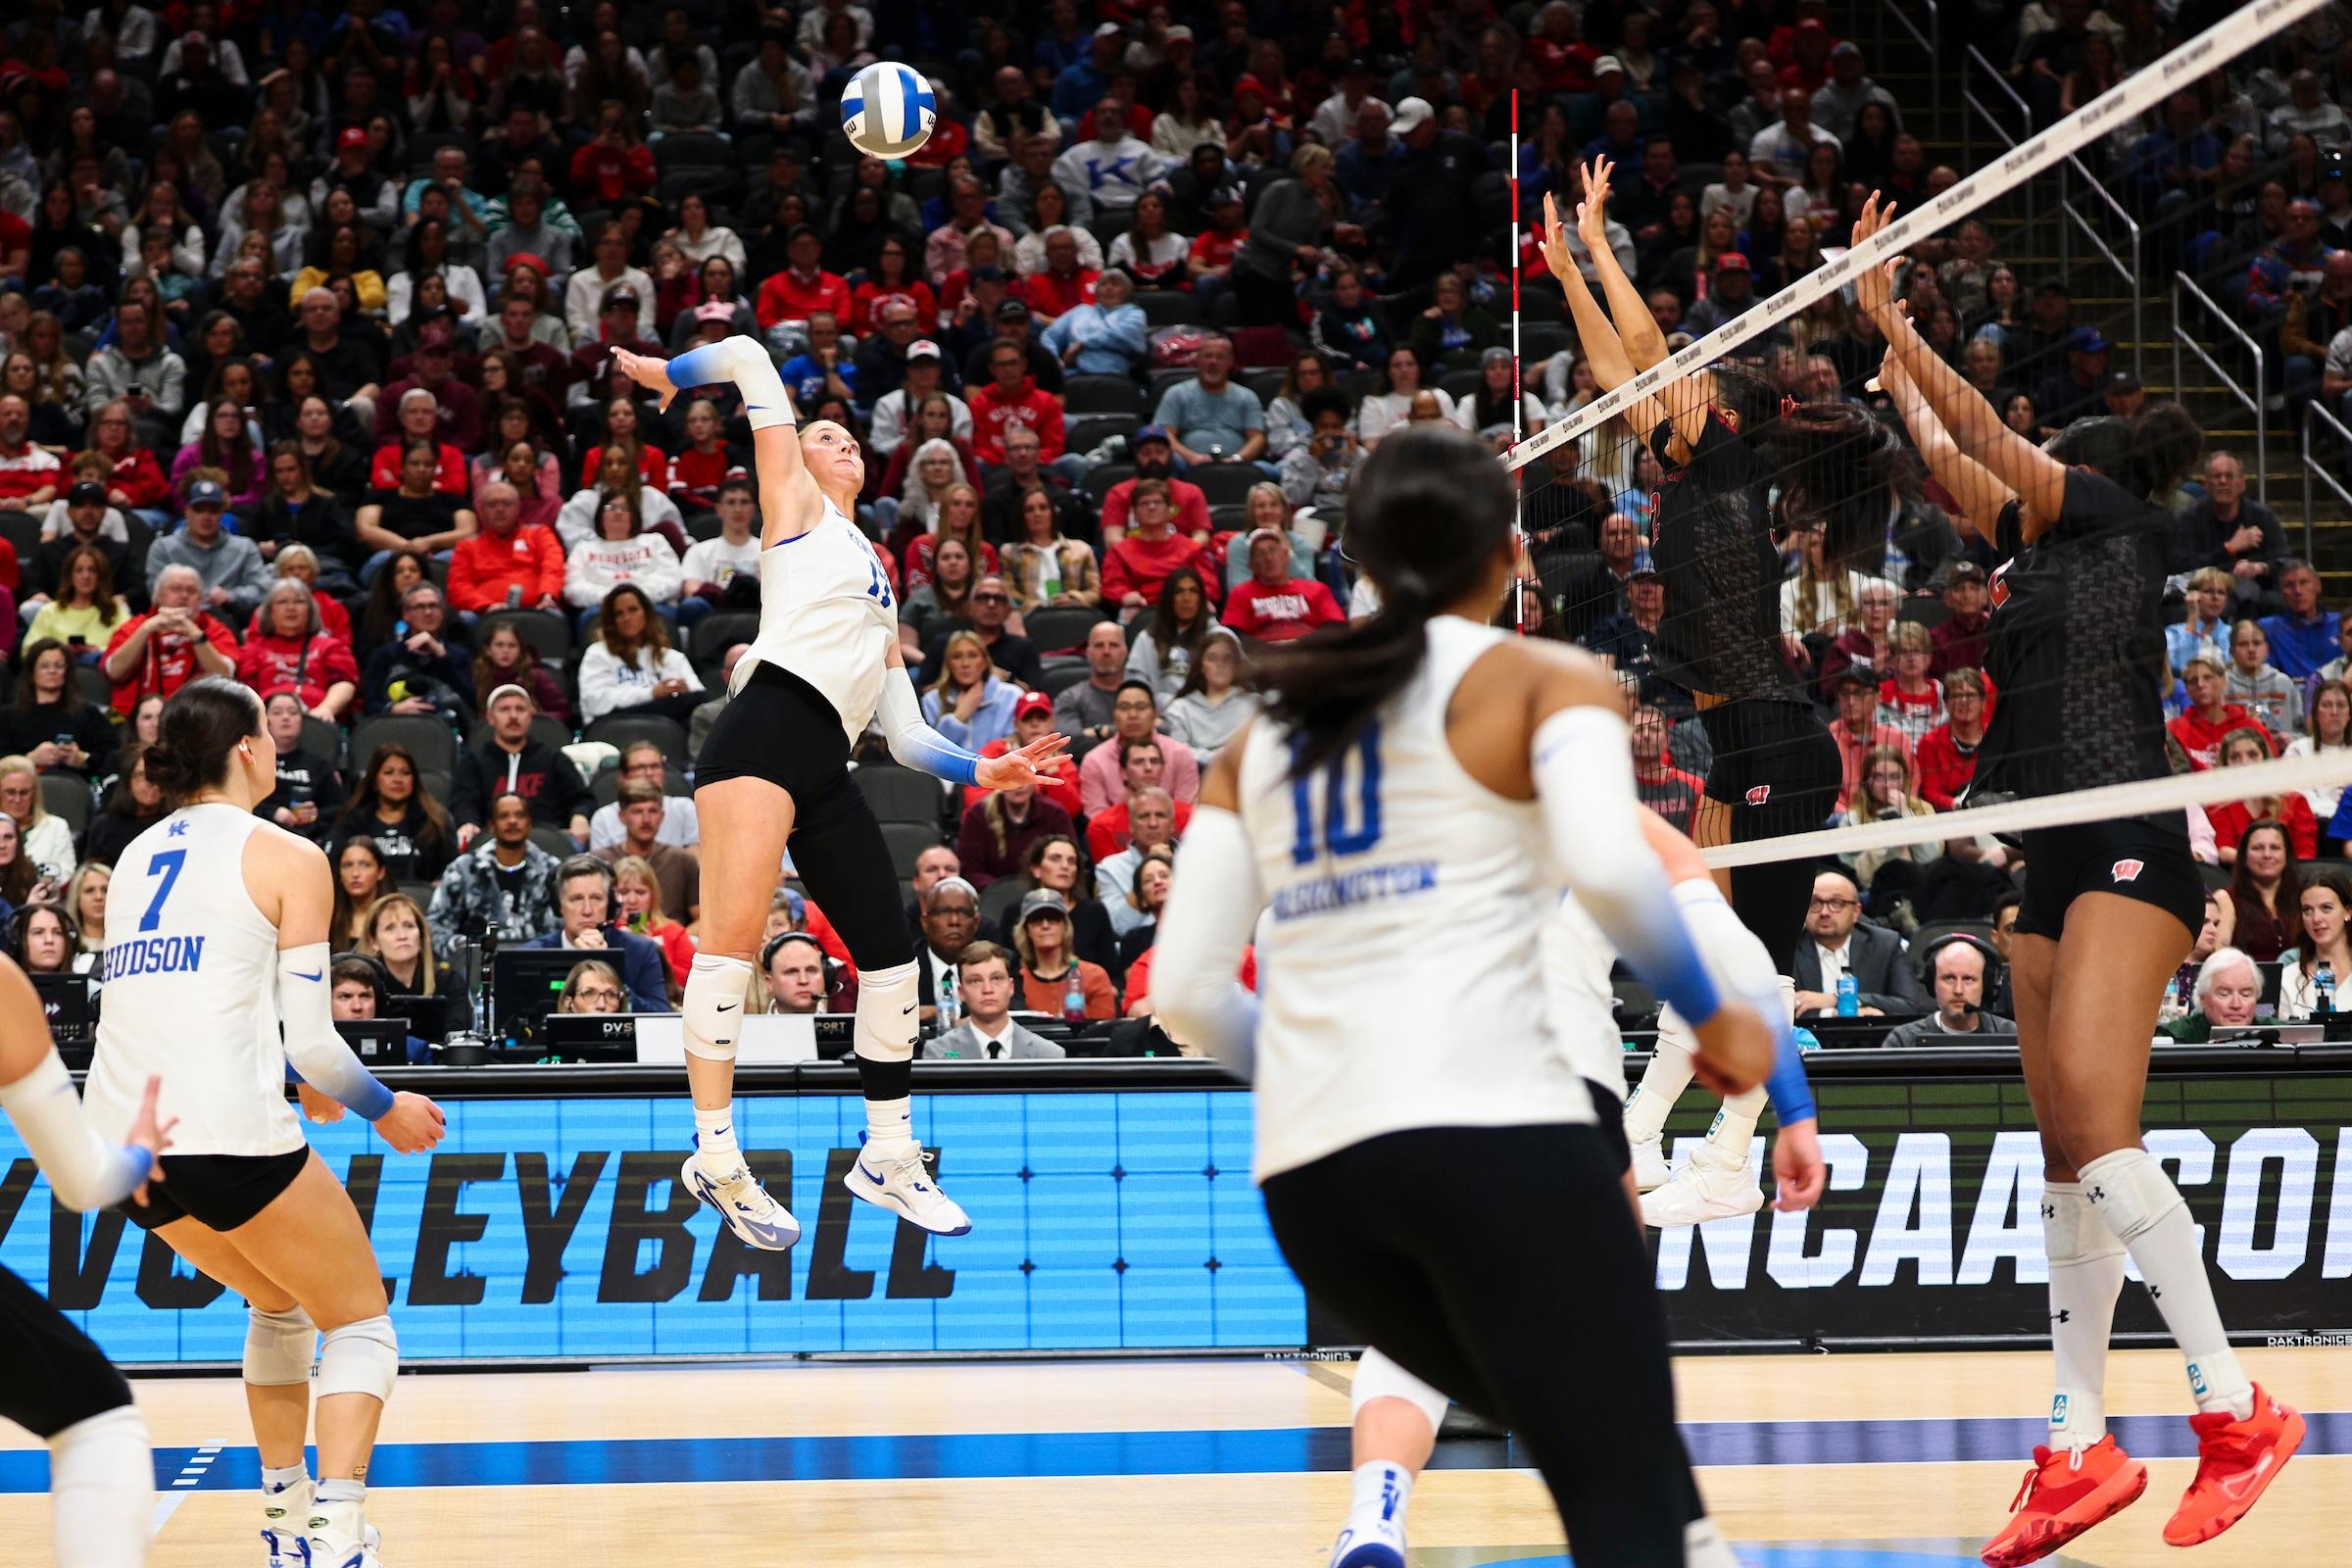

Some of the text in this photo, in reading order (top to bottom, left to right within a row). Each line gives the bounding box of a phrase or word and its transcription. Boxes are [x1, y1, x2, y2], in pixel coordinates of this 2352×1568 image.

[138, 849, 187, 932] 7
[102, 936, 205, 983] HUDSON
[602, 1022, 633, 1032] DVS
[2267, 1336, 2352, 1346] DAKTRONICS
